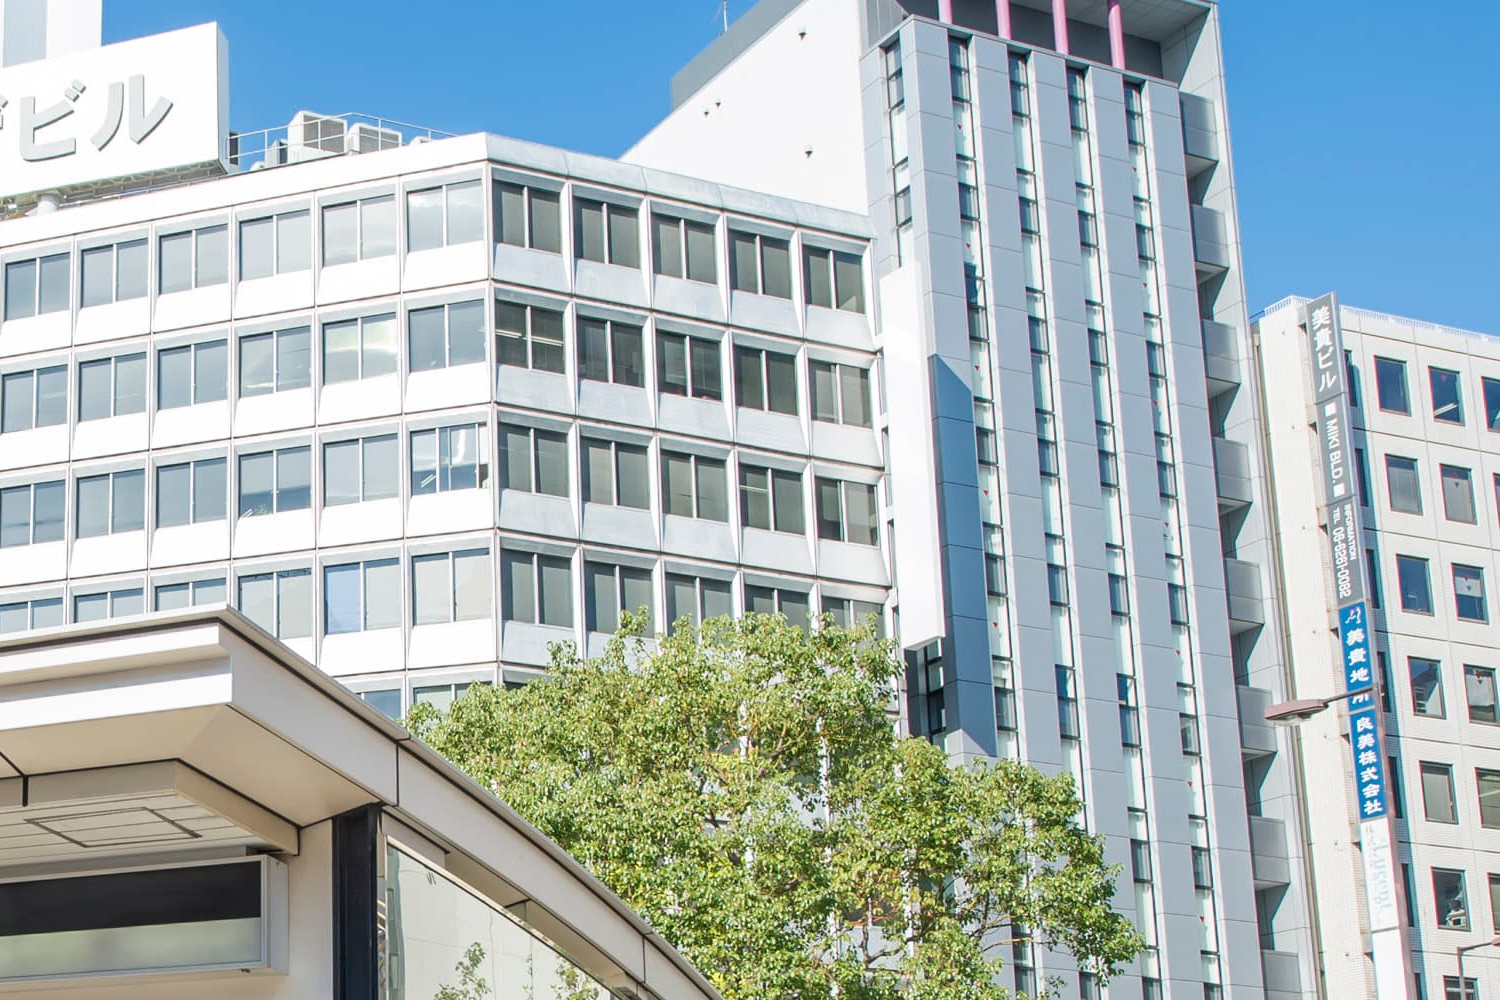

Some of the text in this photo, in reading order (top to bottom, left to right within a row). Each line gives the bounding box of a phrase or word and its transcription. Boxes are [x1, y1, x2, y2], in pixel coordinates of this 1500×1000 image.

[1312, 305, 1337, 393] 美貴ビル
[1326, 418, 1345, 484] MIKI BLD.
[1332, 507, 1342, 525] TEL
